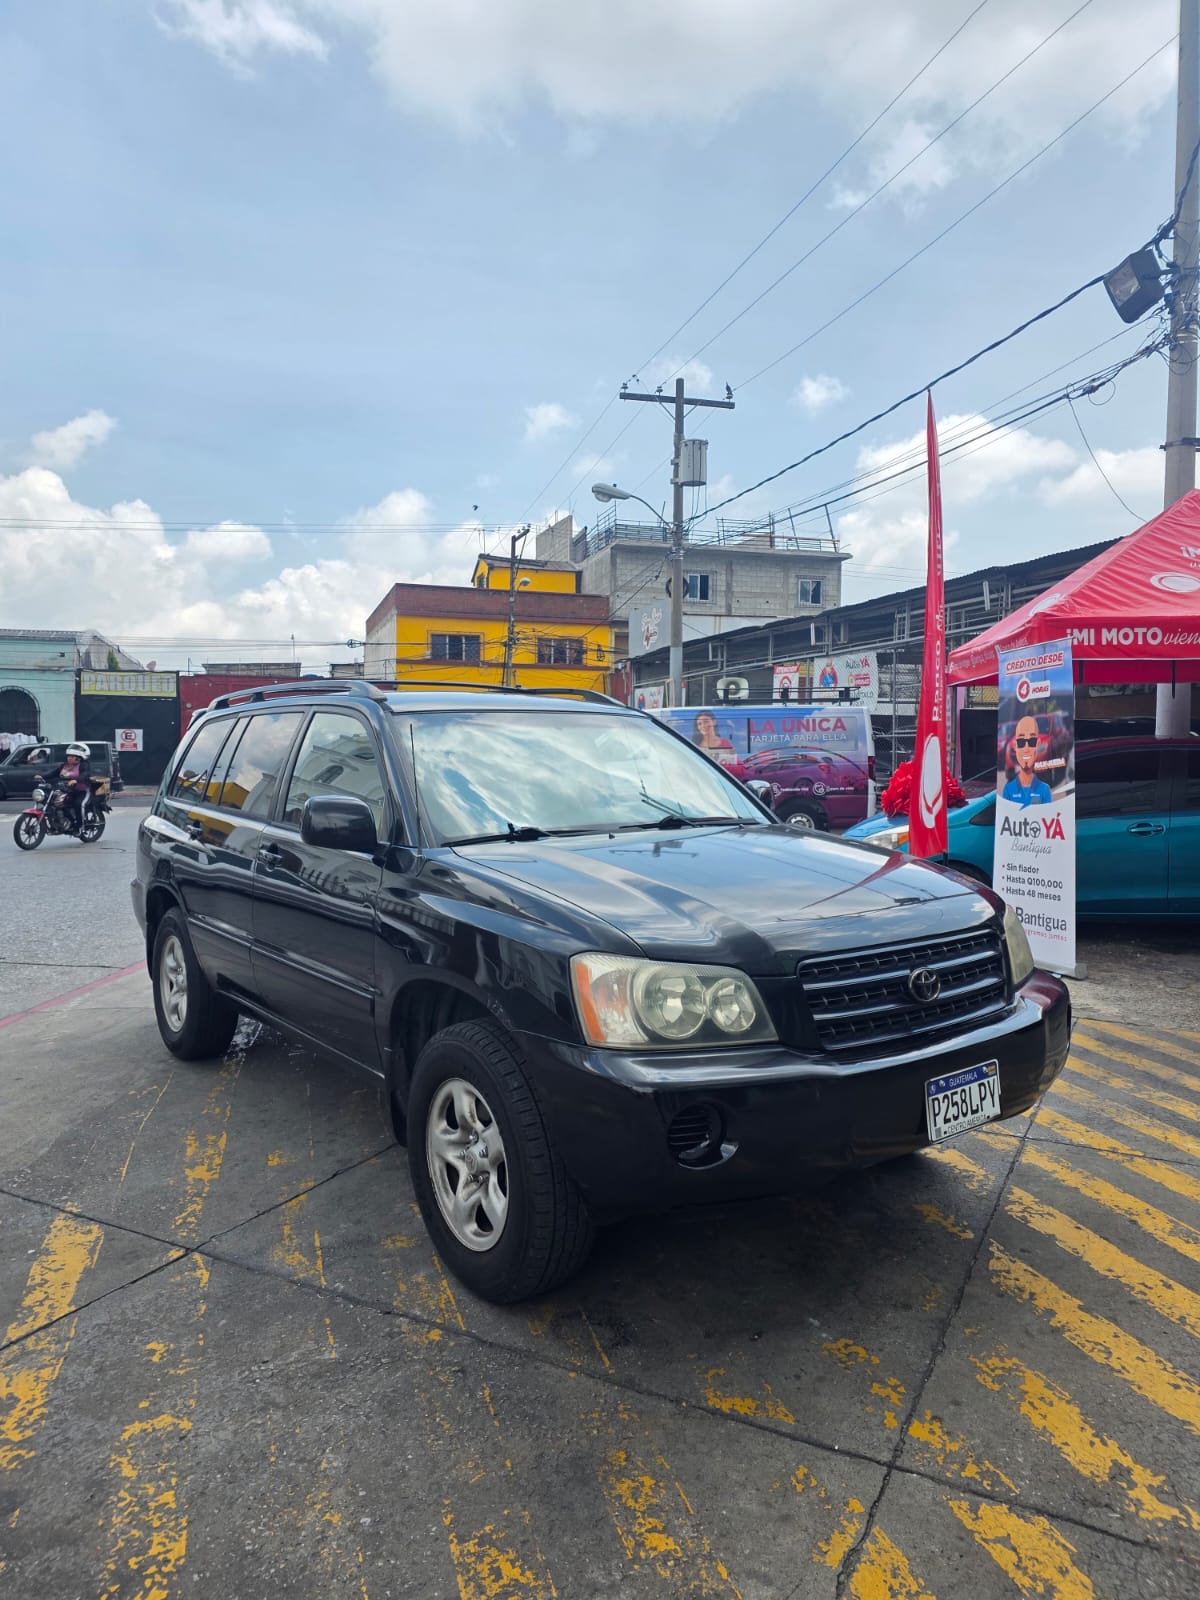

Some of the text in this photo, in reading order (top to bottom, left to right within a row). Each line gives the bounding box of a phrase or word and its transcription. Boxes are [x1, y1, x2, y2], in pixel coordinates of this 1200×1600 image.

[1101, 627, 1163, 645] MOTO
[1163, 628, 1200, 645] vien
[1037, 652, 1064, 665] DESDE
[83, 673, 176, 694] PARQUEO
[1020, 683, 1049, 697] 4 HORAS
[750, 719, 776, 735] LA
[751, 732, 847, 743] TARJETA PARA ELLA
[1011, 838, 1052, 858] Bantigua
[1006, 863, 1040, 874] Sin fiador
[1006, 875, 1064, 889] Hasta Q100,000
[1006, 886, 1062, 902] Hasta 48 meses
[1015, 906, 1067, 932] Bantigua
[949, 1071, 978, 1088] GUATEMALA
[931, 1077, 996, 1128] P258LPY
[947, 1119, 967, 1133] CENTRO
